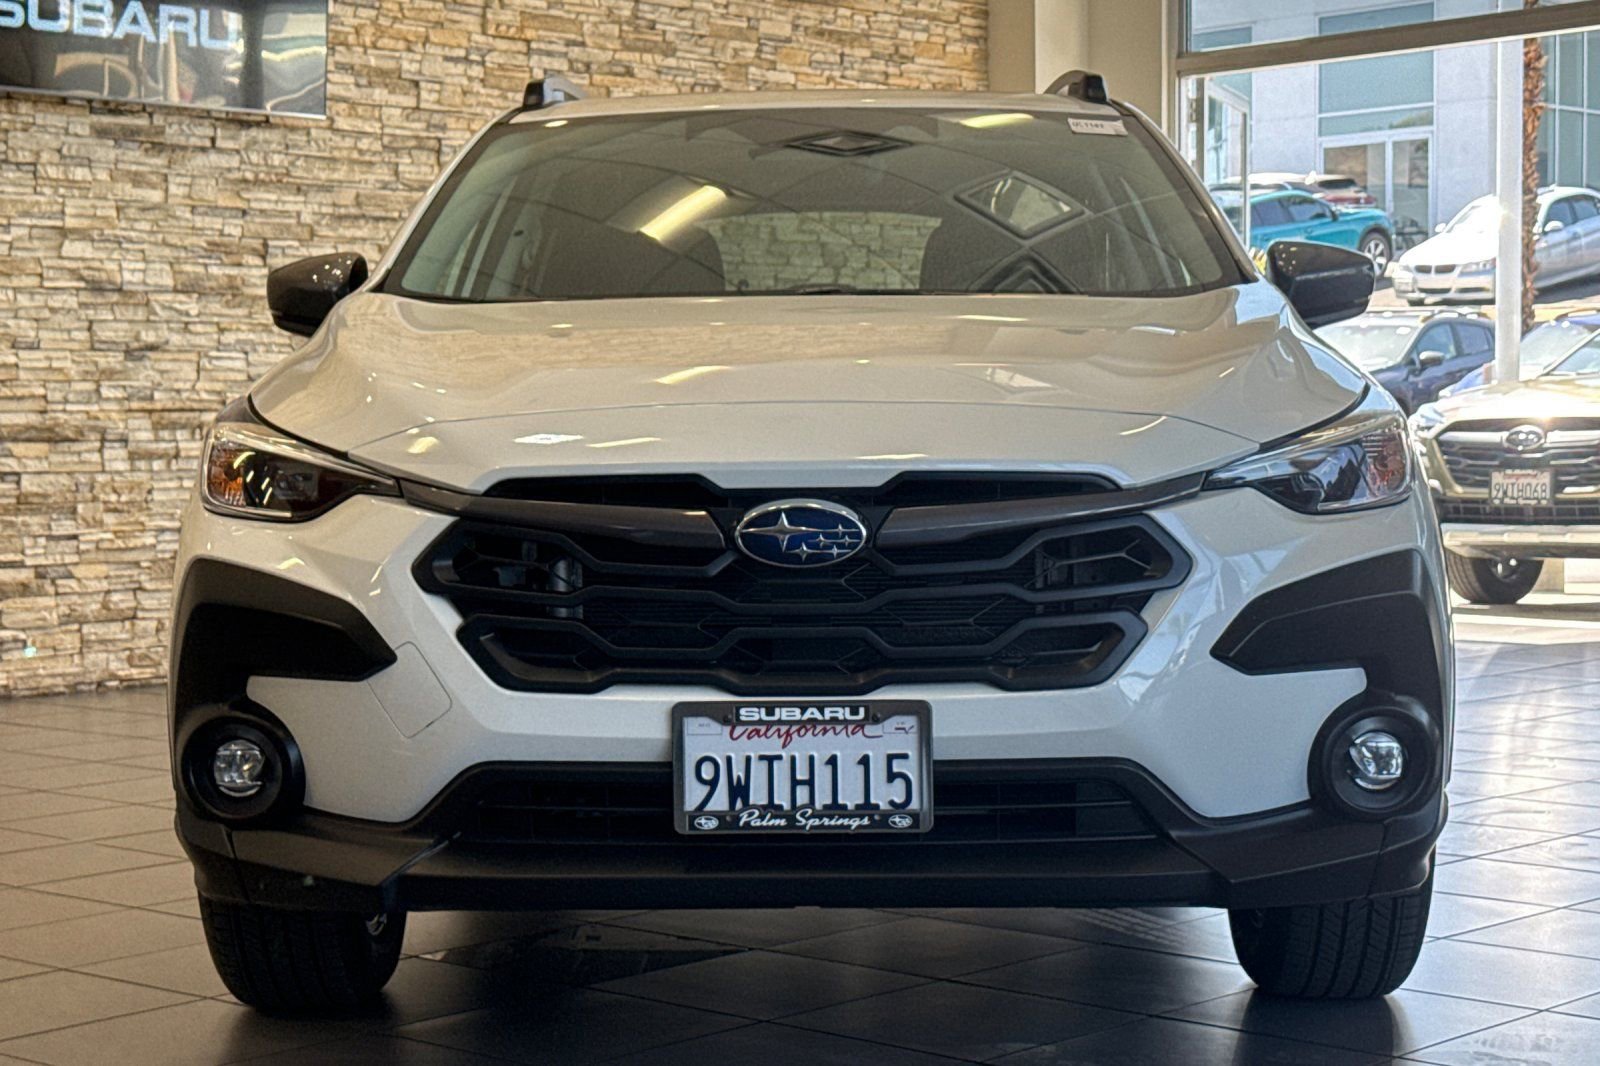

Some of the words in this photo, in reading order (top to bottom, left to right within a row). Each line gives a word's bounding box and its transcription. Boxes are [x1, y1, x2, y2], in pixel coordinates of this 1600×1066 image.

[739, 707, 865, 721] SUBARU
[739, 809, 787, 827] Palm
[795, 809, 871, 831] Springs
